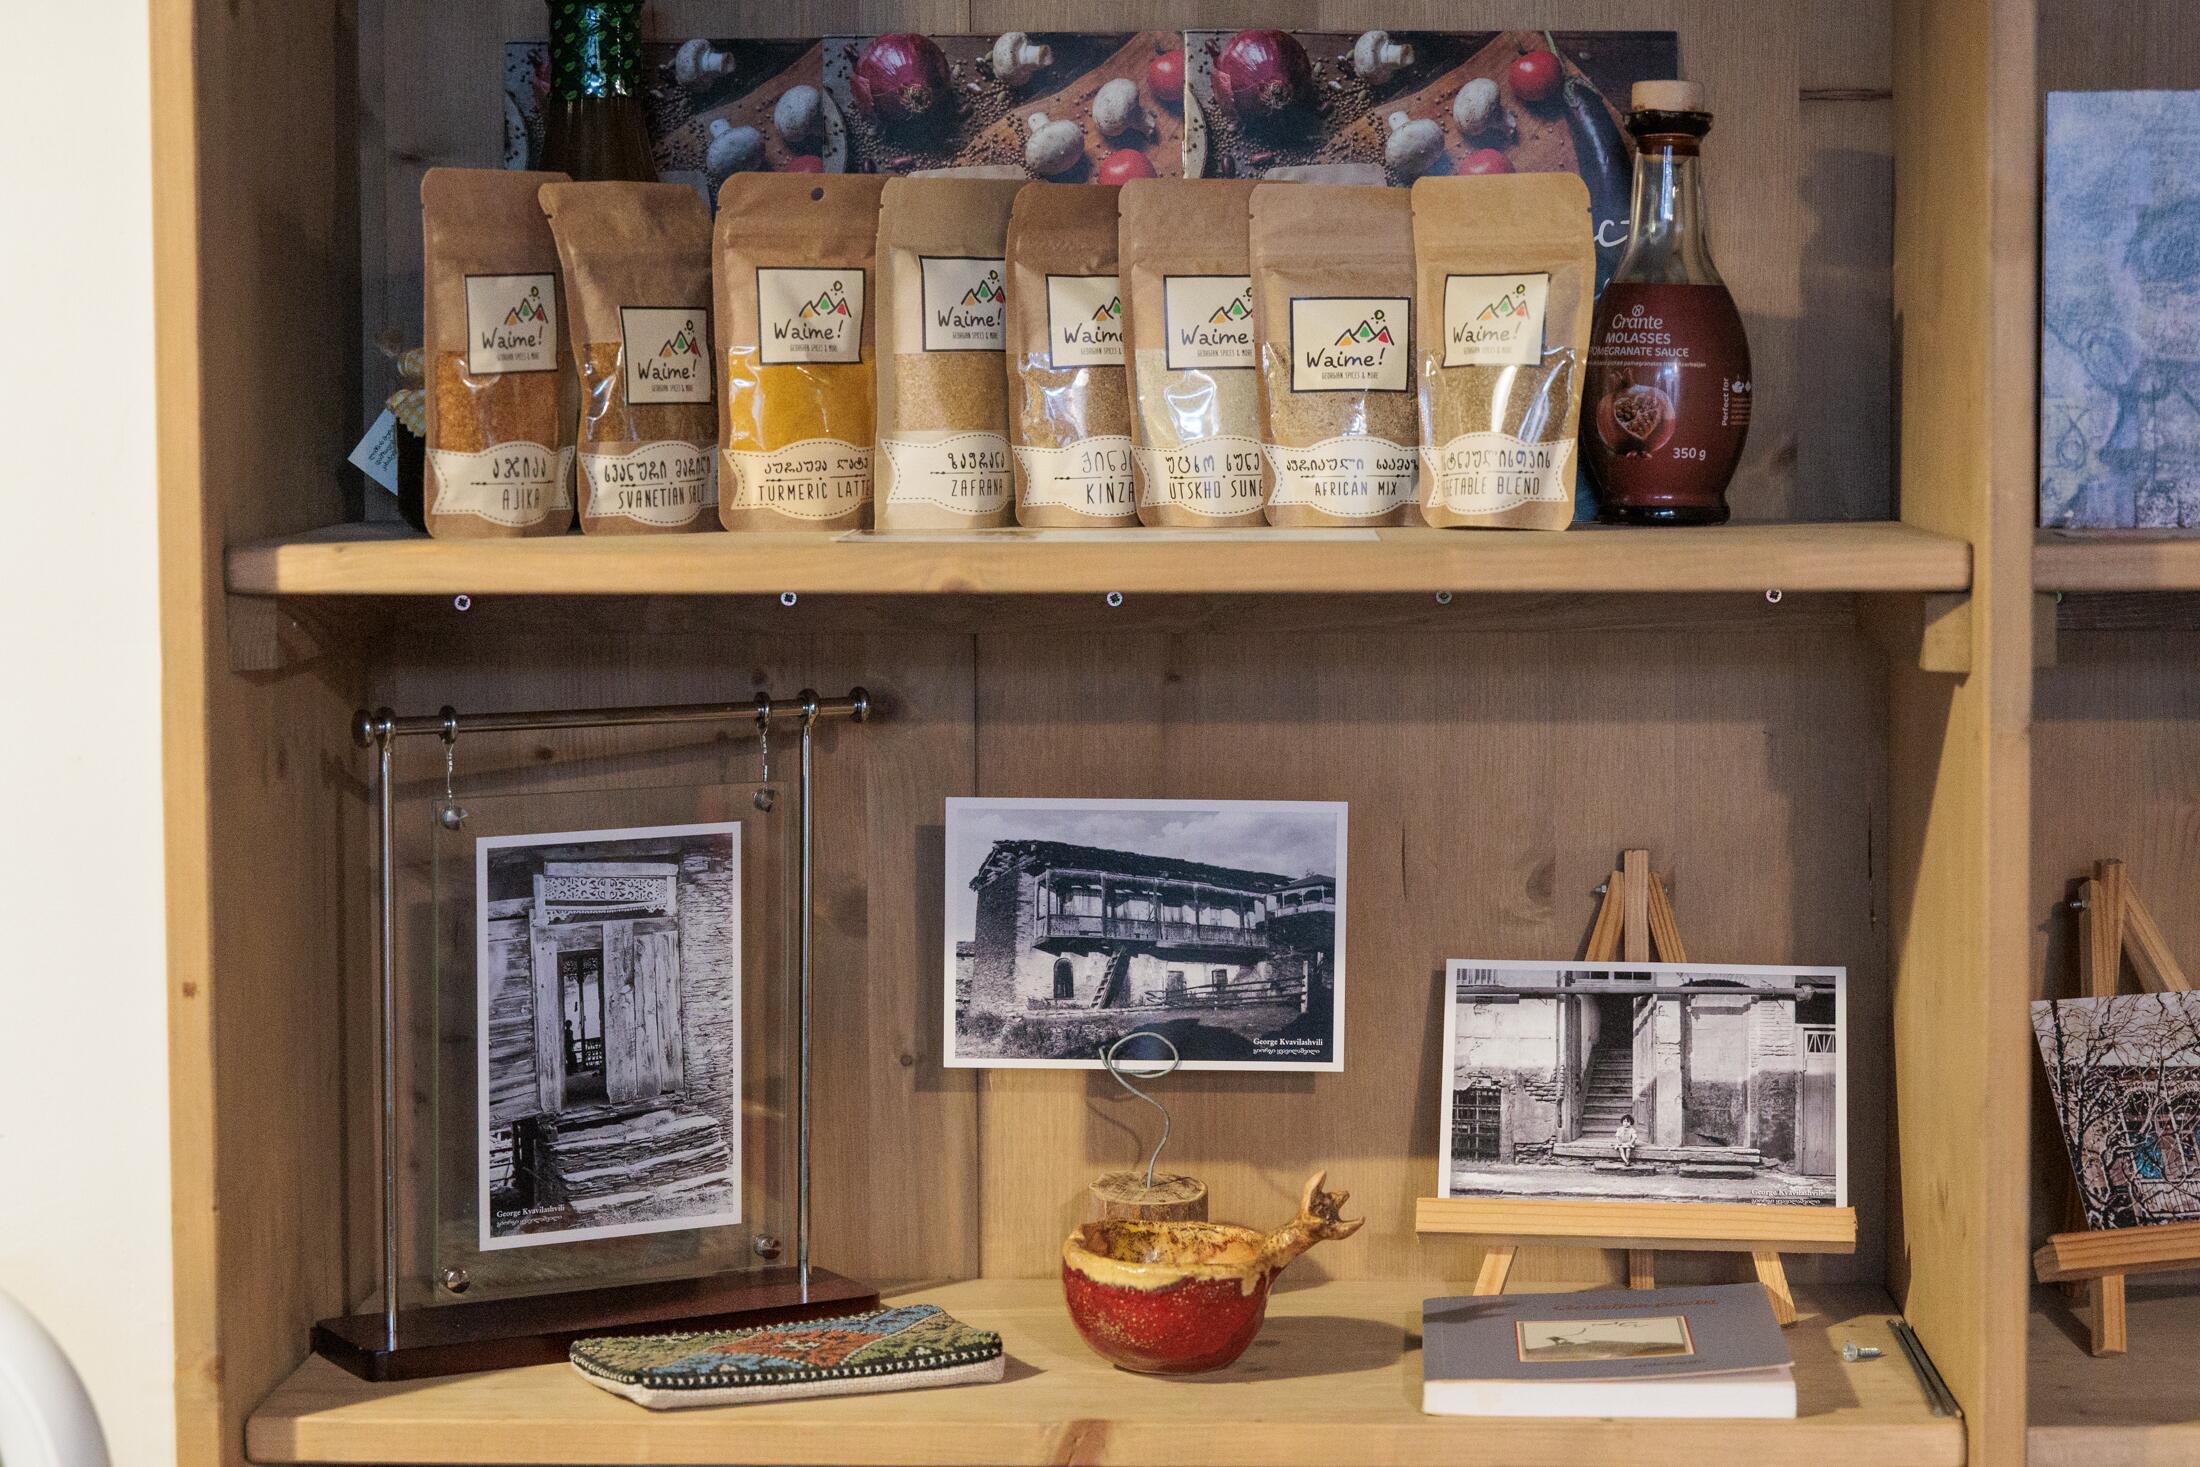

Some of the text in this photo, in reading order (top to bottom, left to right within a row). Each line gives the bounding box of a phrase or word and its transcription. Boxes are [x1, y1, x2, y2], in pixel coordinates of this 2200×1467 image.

[937, 306, 1002, 328] Waime!
[482, 326, 543, 349] Waime!
[774, 318, 844, 340] Waime!
[1181, 325, 1255, 346] Waime
[1453, 321, 1522, 343] Waime!
[1605, 332, 1671, 345] MOLASSES
[1307, 347, 1386, 368] Waime!
[1655, 348, 1689, 358] SAUCE
[637, 358, 697, 381] Waime!
[1722, 377, 1730, 391] for
[947, 452, 1005, 470] ზაფრანა
[1673, 447, 1706, 461] 350 g
[604, 461, 667, 483] სვანური
[1165, 455, 1215, 474] უცხო
[758, 481, 828, 501] TURMERIC
[951, 478, 1003, 497] ZAFRANA
[1086, 482, 1135, 505] KINZA
[1169, 480, 1221, 499] UTSKHO
[1315, 481, 1398, 496] AFRICAN MIX
[1497, 477, 1540, 495] BLEND
[502, 488, 540, 510] AJIKA
[618, 483, 705, 509] SVANETIAN SALT
[1253, 1038, 1323, 1046] George Kvavilashvili
[1751, 1188, 1776, 1197] George
[522, 1204, 565, 1215] Kvavilashvili
